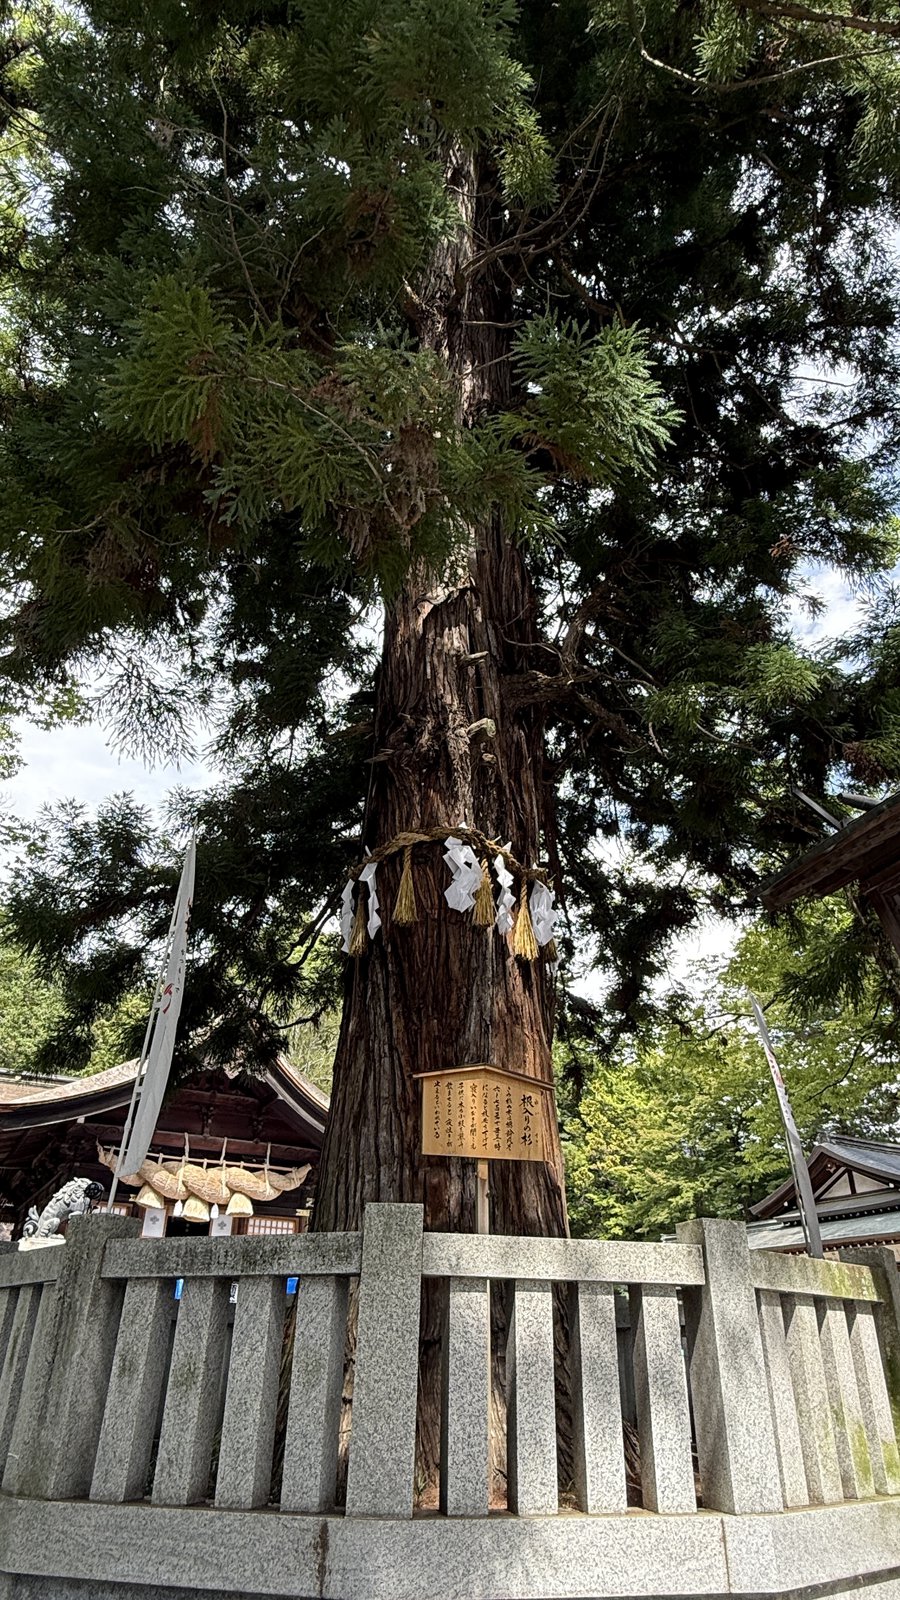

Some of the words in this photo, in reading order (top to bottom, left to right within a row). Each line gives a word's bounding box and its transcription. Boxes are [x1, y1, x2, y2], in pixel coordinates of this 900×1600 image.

[519, 1094, 534, 1146] 根入りの杉
